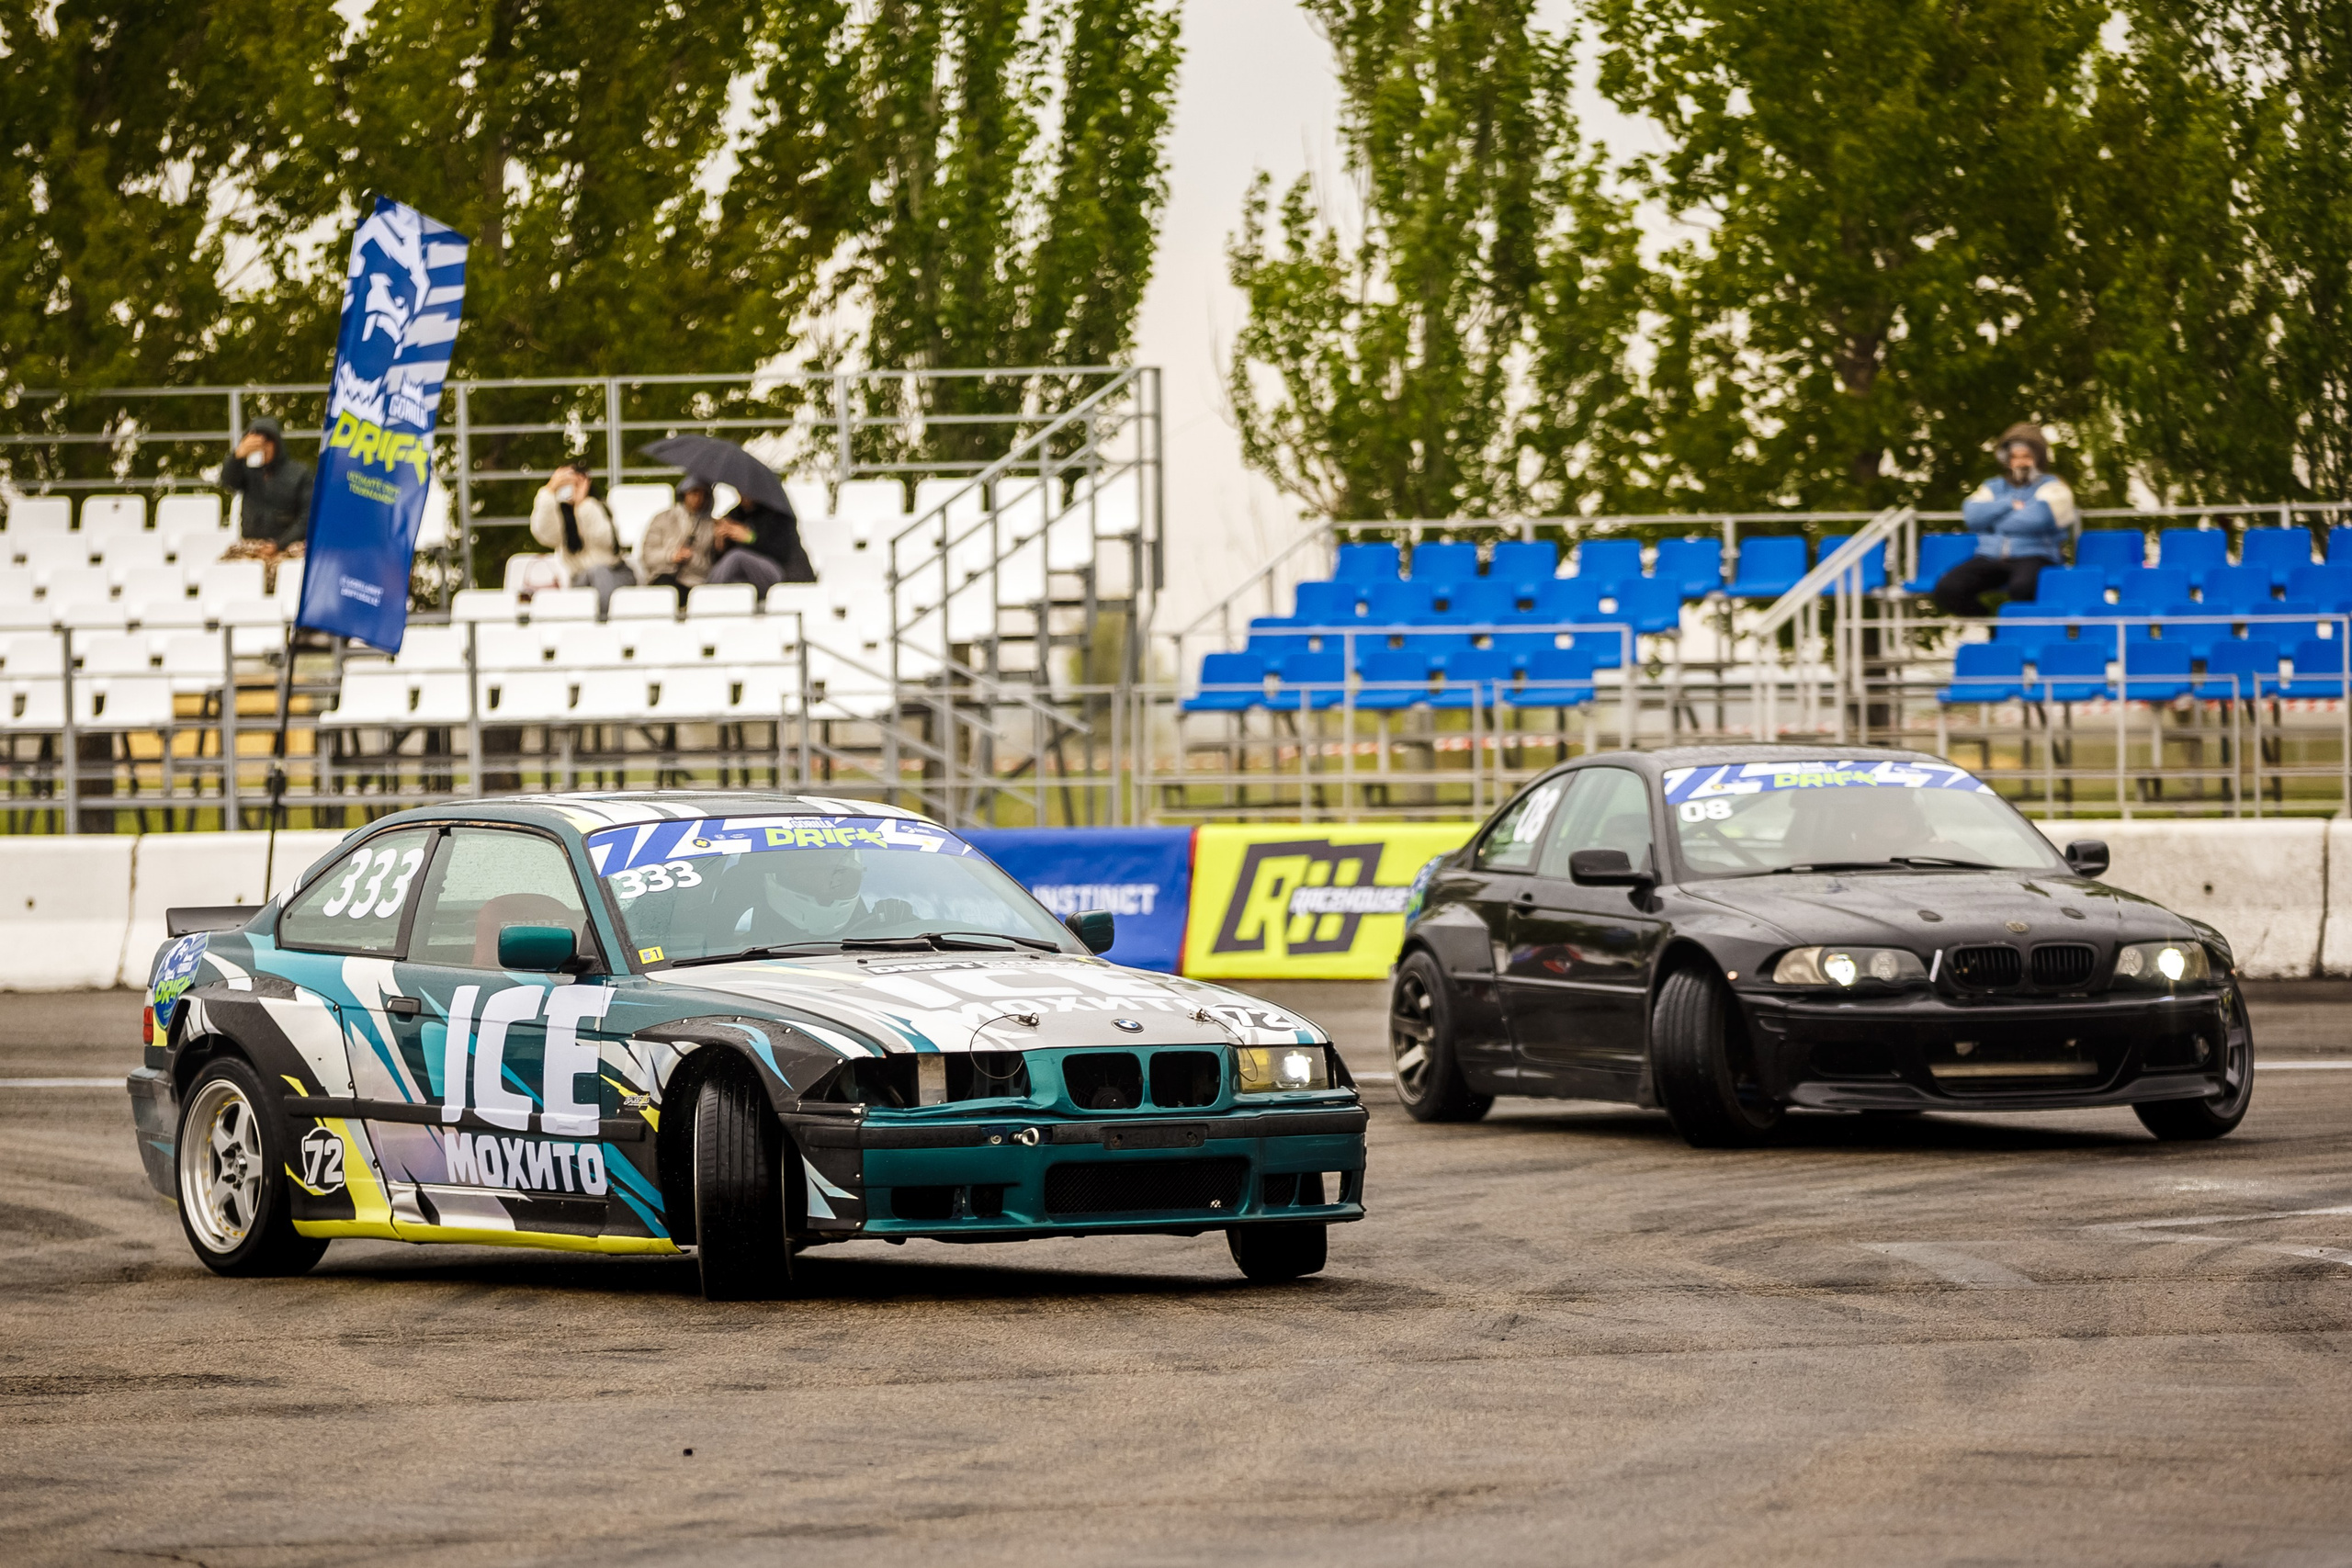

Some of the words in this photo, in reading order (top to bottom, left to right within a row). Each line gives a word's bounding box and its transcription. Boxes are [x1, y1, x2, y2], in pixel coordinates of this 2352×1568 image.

[329, 409, 428, 486] DRIFT
[1774, 771, 1878, 788] DRIFT
[790, 819, 837, 829] GORILLA
[1513, 787, 1560, 843] 08
[1679, 798, 1733, 823] 08
[765, 827, 888, 849] DRIFT
[322, 848, 424, 919] 333
[612, 861, 702, 899] 333
[866, 961, 977, 975] DRIFT
[1216, 1006, 1300, 1029] 72
[441, 985, 618, 1137] ICE
[305, 1137, 344, 1186] 72
[444, 1133, 608, 1196] МОХИТО
